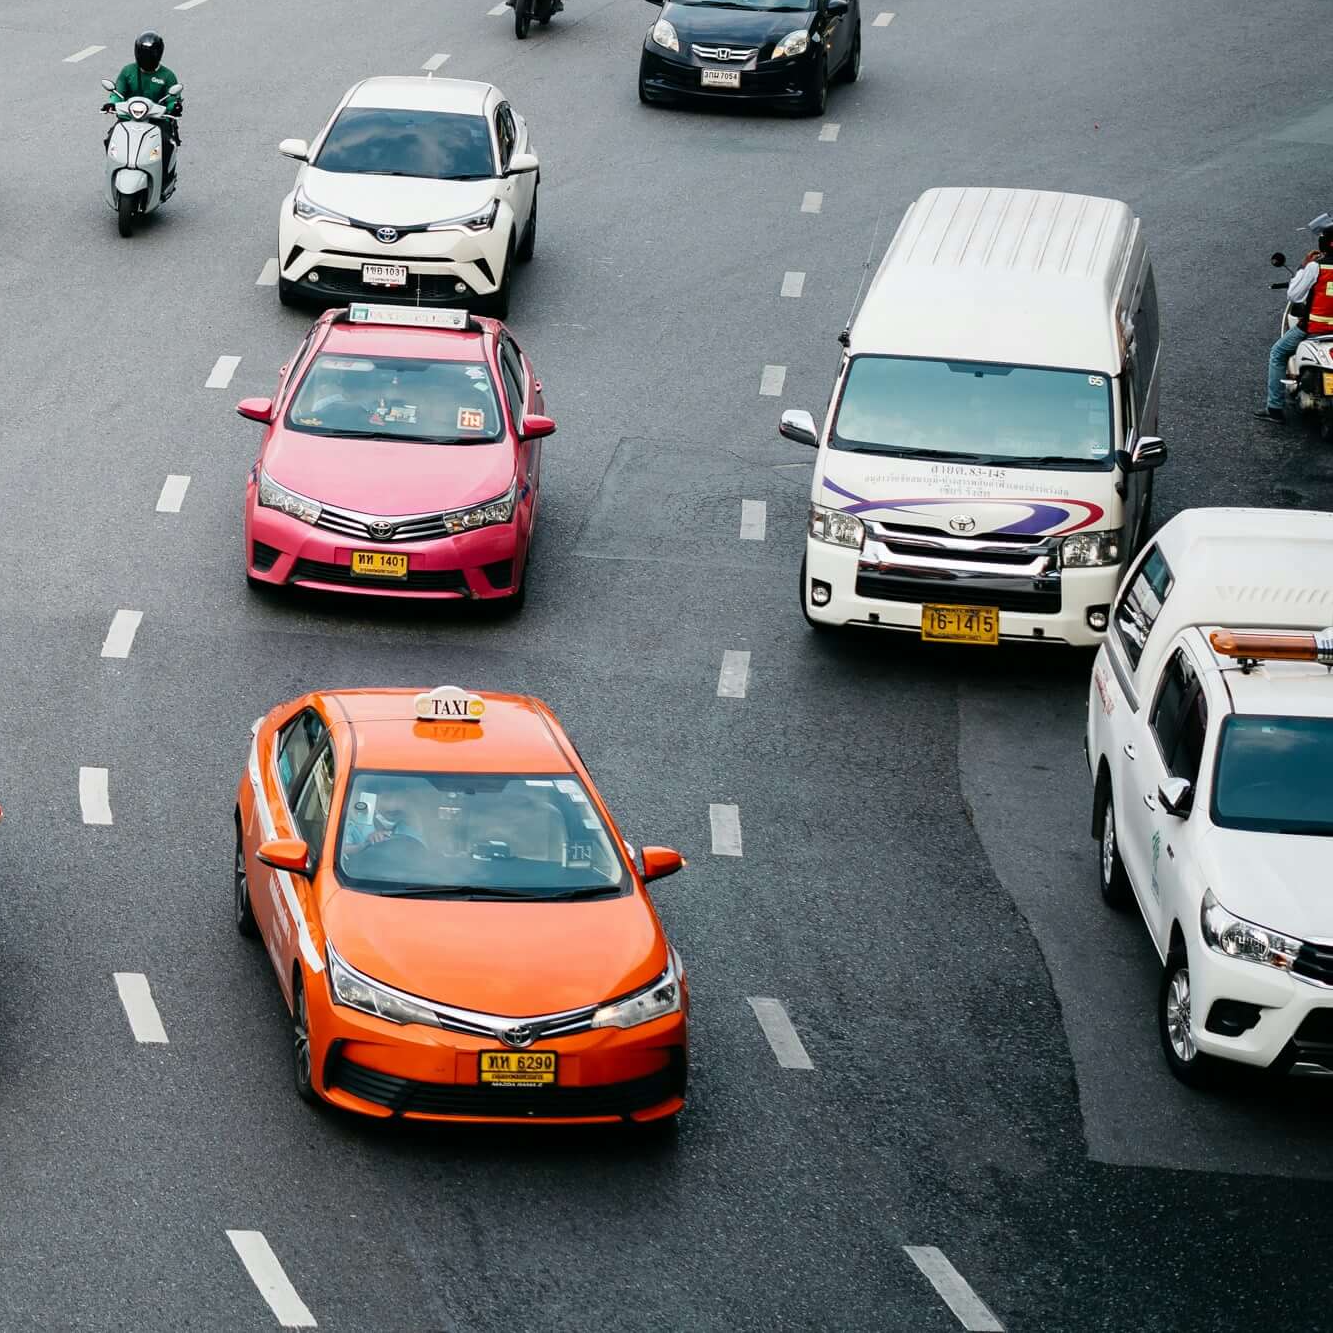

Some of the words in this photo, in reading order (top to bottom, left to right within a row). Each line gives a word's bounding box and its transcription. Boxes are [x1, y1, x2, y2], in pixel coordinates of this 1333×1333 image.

[385, 267, 405, 277] 1031
[380, 555, 404, 568] 1401
[930, 612, 993, 633] 16-1415
[431, 699, 470, 716] TAXI
[517, 1055, 553, 1070] 6290
